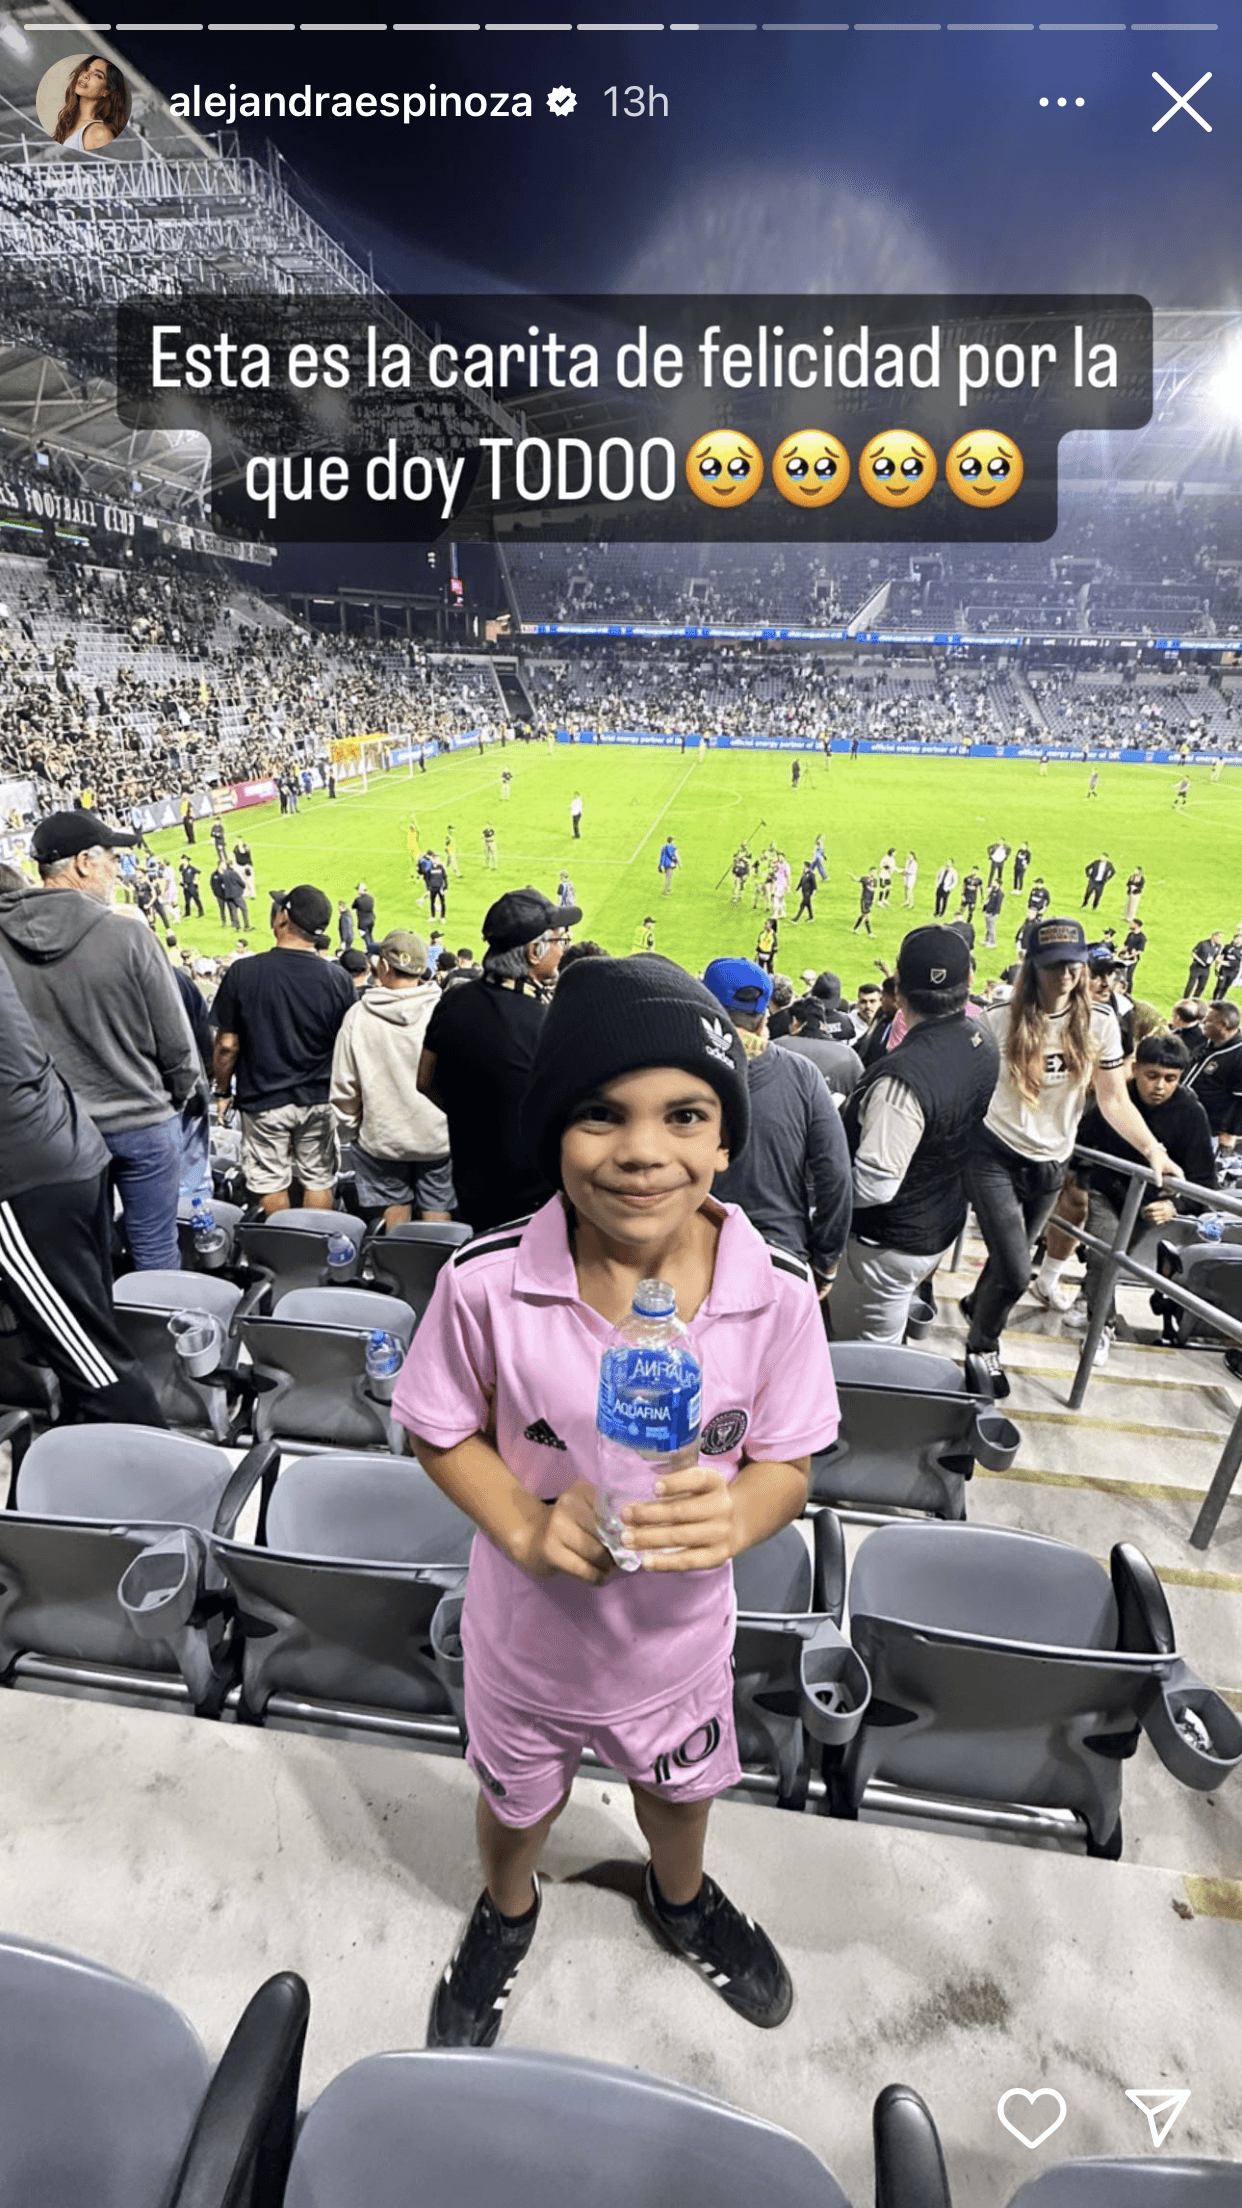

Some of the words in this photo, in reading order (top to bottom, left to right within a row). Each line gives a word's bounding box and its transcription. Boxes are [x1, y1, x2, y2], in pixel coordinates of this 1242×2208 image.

[24, 486, 97, 527] FOOTBALL
[104, 505, 135, 536] CLUB
[705, 1044, 735, 1070] adidas
[612, 1397, 672, 1422] AQUAFINA
[652, 1715, 721, 1785] 10
